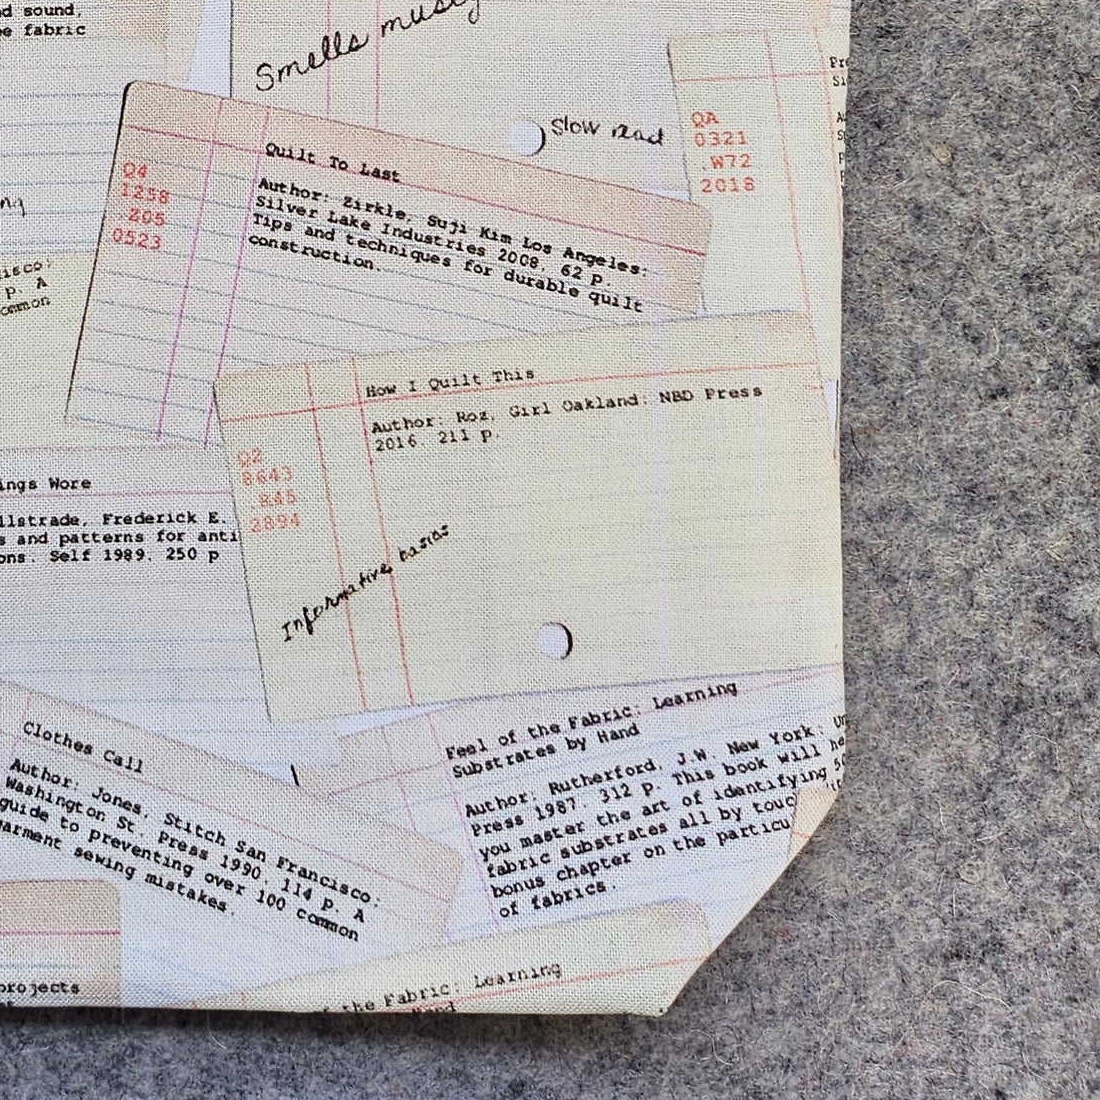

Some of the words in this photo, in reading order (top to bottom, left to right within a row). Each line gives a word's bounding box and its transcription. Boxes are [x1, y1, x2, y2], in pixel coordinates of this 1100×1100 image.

[256, 30, 370, 92] Smells
[265, 141, 315, 165] Quilt
[329, 155, 349, 171] To
[358, 162, 400, 183] Last
[252, 212, 292, 232] Tips
[304, 226, 336, 242] and
[345, 233, 451, 267] techniques
[463, 258, 493, 276] for
[503, 268, 580, 298] durable
[588, 291, 642, 313] quilt
[365, 384, 397, 398] How
[408, 380, 417, 392] I
[428, 373, 481, 392] Quilt
[491, 369, 534, 383] This
[48, 476, 91, 490] Wore
[23, 721, 93, 755] Clothes
[103, 749, 143, 774] Call
[445, 737, 488, 760] Feel
[497, 729, 517, 747] of
[527, 723, 561, 739] the
[652, 682, 738, 710] Learning
[452, 743, 556, 779] Substrates
[564, 736, 586, 752] by
[596, 722, 640, 744] Hand
[60, 815, 79, 832] to
[87, 828, 194, 878] preventing
[204, 872, 246, 896] over
[256, 889, 286, 911] 100
[296, 907, 358, 942] common
